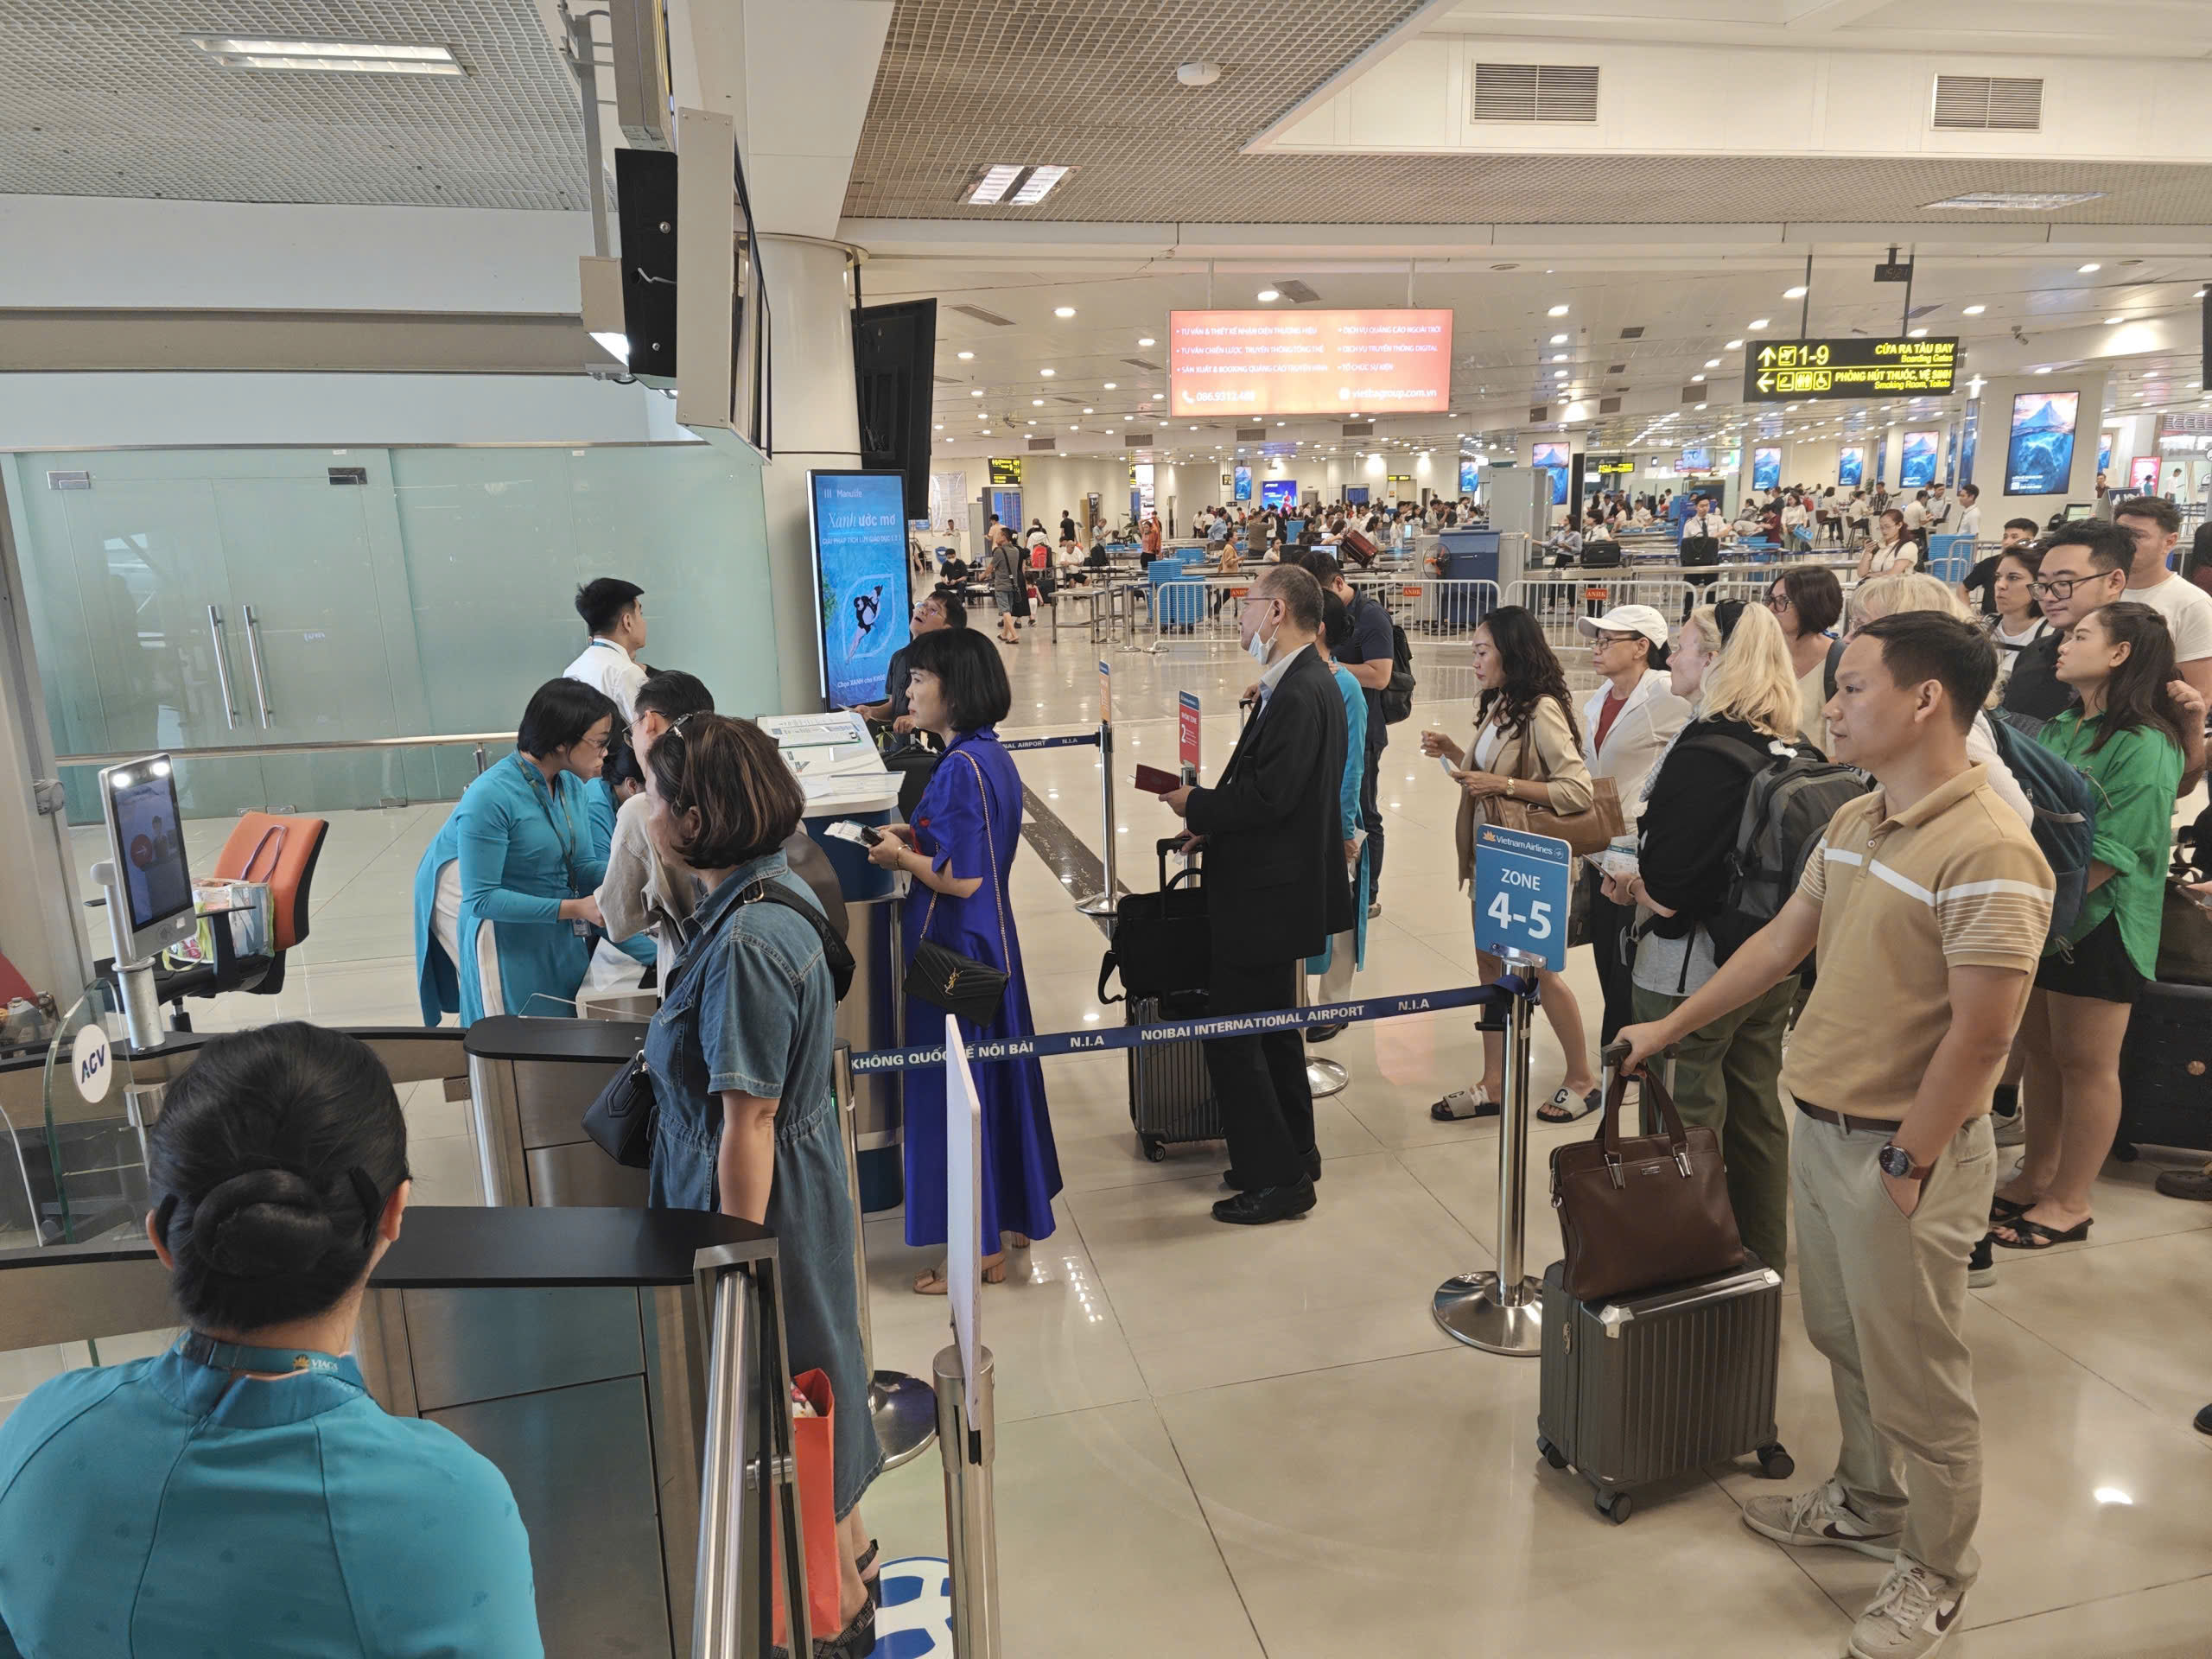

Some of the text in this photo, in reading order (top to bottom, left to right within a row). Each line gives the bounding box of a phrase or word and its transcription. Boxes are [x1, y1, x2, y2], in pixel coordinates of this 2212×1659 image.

[1798, 345, 1830, 366] 1-9
[1897, 343, 1913, 355] RA
[1935, 343, 1955, 354] BAY
[1901, 353, 1954, 364] Boarding Gates
[1874, 381, 1904, 391] Smoking
[1929, 380, 1950, 389] Toilets
[1017, 740, 1046, 749] AIRPORT
[1501, 868, 1541, 891] ZONE
[1487, 891, 1552, 939] 4-5
[851, 1053, 905, 1071] KHÔNG
[978, 1043, 1005, 1059] NỘI
[1009, 1039, 1033, 1055] BÀI
[1070, 1035, 1105, 1048] N.I.A
[1141, 1026, 1191, 1041] NOIBAI
[1194, 1012, 1303, 1035] INTERNATIONAL
[1306, 1004, 1365, 1022] AIRPORT
[1398, 998, 1430, 1012] N.I.A
[81, 1043, 105, 1084] ACV
[1554, 1088, 1569, 1104] G
